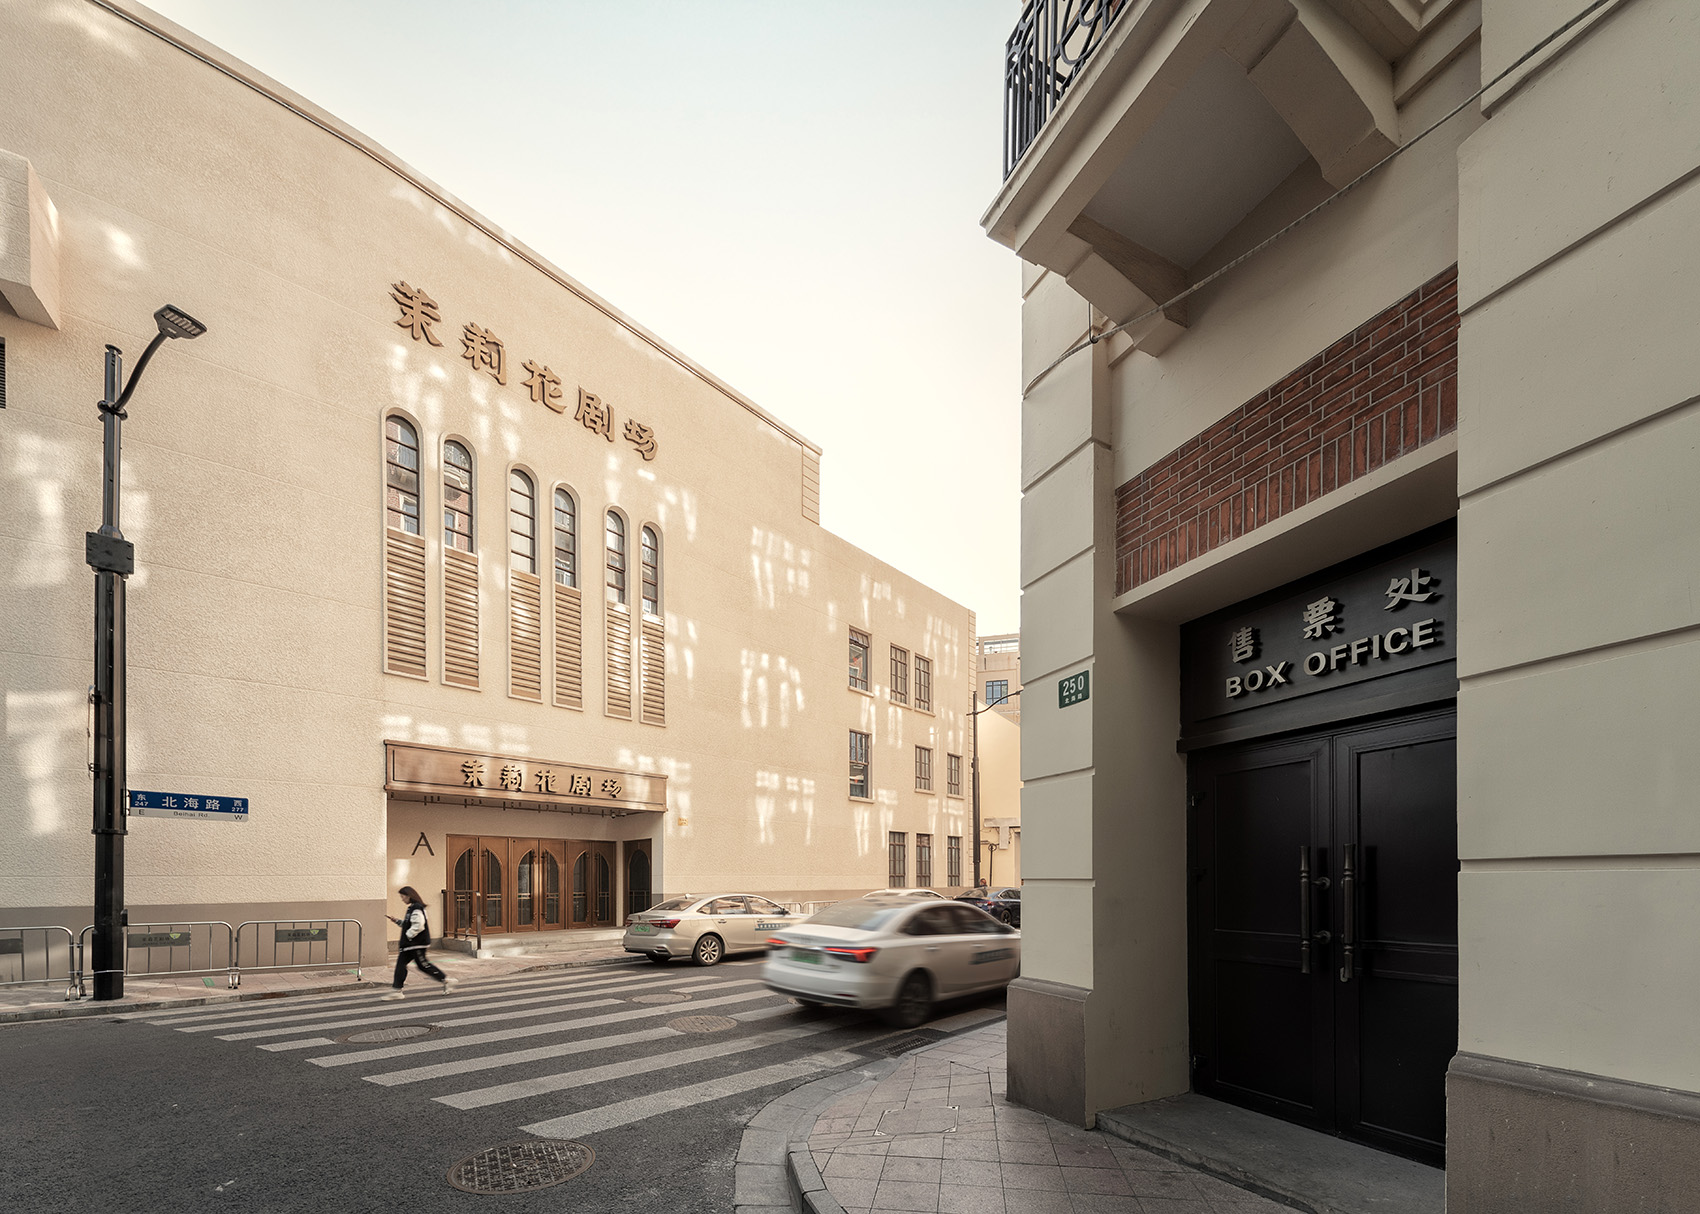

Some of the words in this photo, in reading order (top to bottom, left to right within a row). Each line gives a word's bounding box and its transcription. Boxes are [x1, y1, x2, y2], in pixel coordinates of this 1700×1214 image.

[387, 279, 660, 462] 茉莉花剧场
[1227, 567, 1437, 664] 售票处
[1225, 660, 1288, 698] BOX
[1303, 617, 1436, 676] OFFICE
[1062, 675, 1084, 696] 250
[461, 759, 623, 798] 茉莉花剧场
[161, 796, 220, 810] 北海路
[173, 810, 196, 818] Beihai
[410, 831, 435, 856] A
